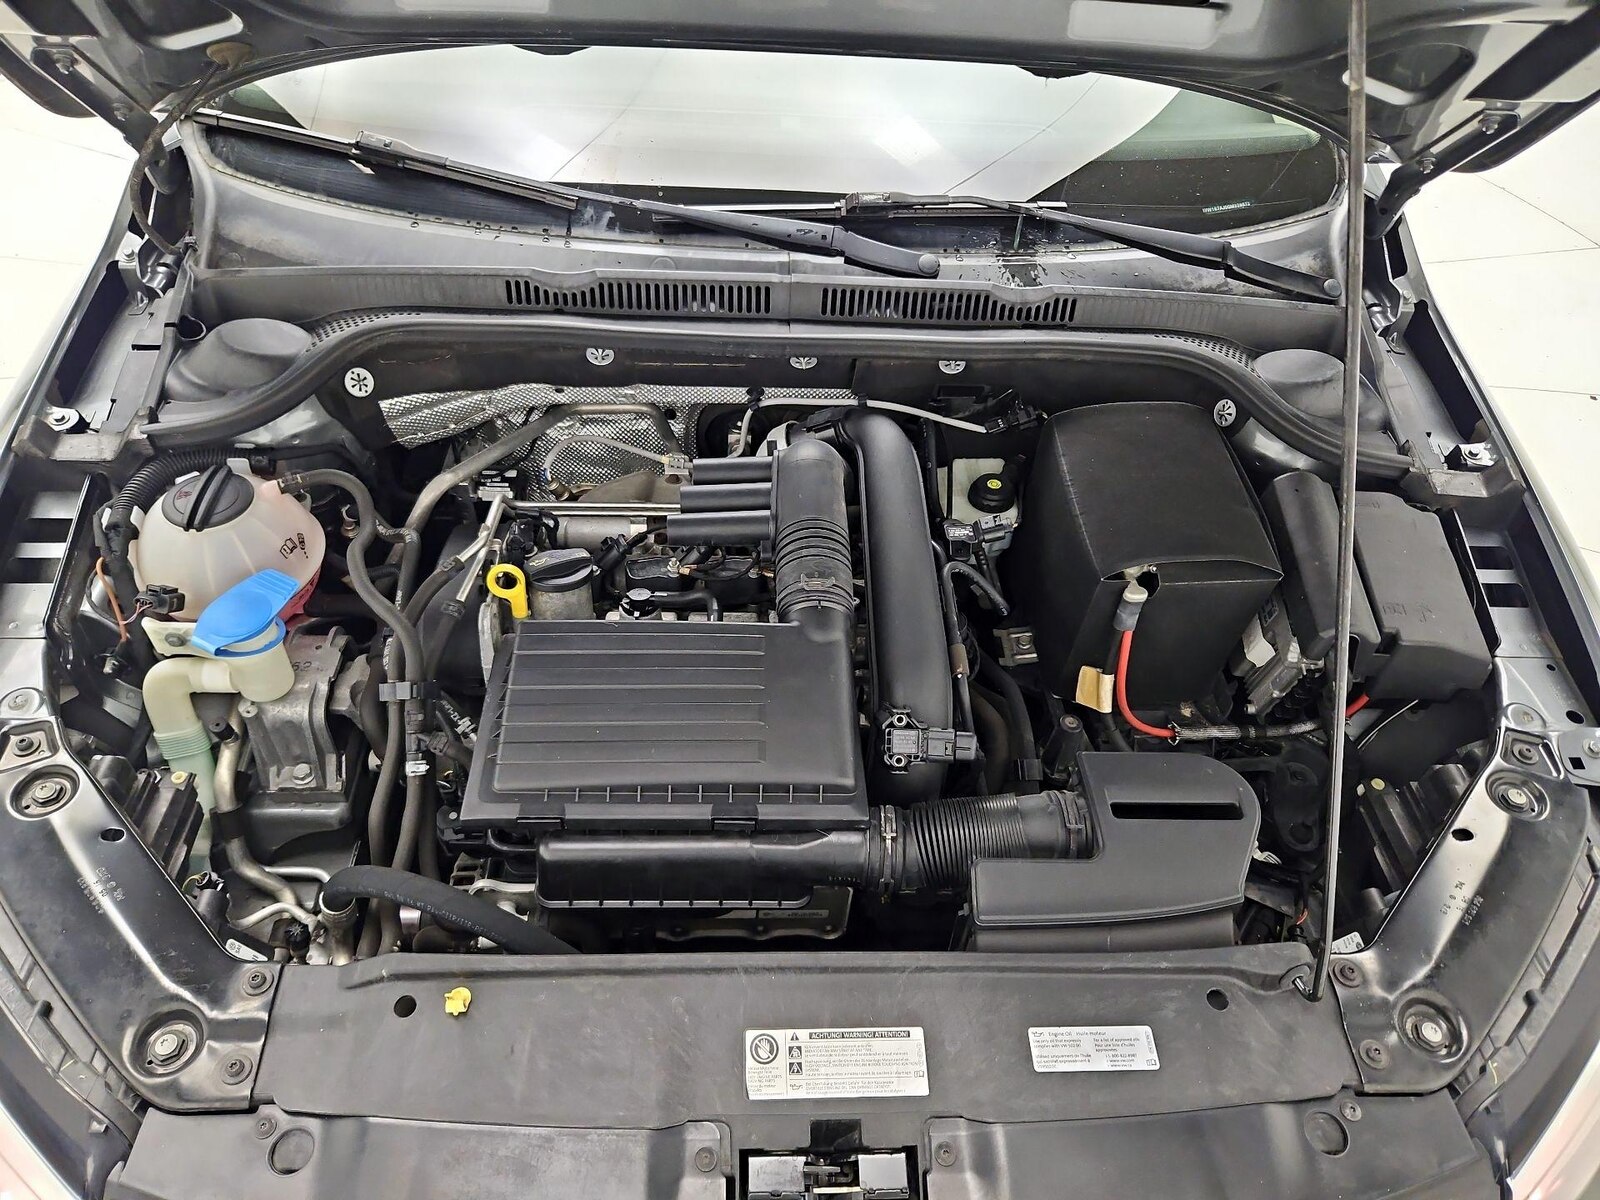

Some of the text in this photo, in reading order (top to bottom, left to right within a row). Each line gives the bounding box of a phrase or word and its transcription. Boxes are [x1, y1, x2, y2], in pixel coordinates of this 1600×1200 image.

[811, 1030, 909, 1040] ACHTUNG! WARNING! ATTENTION!
